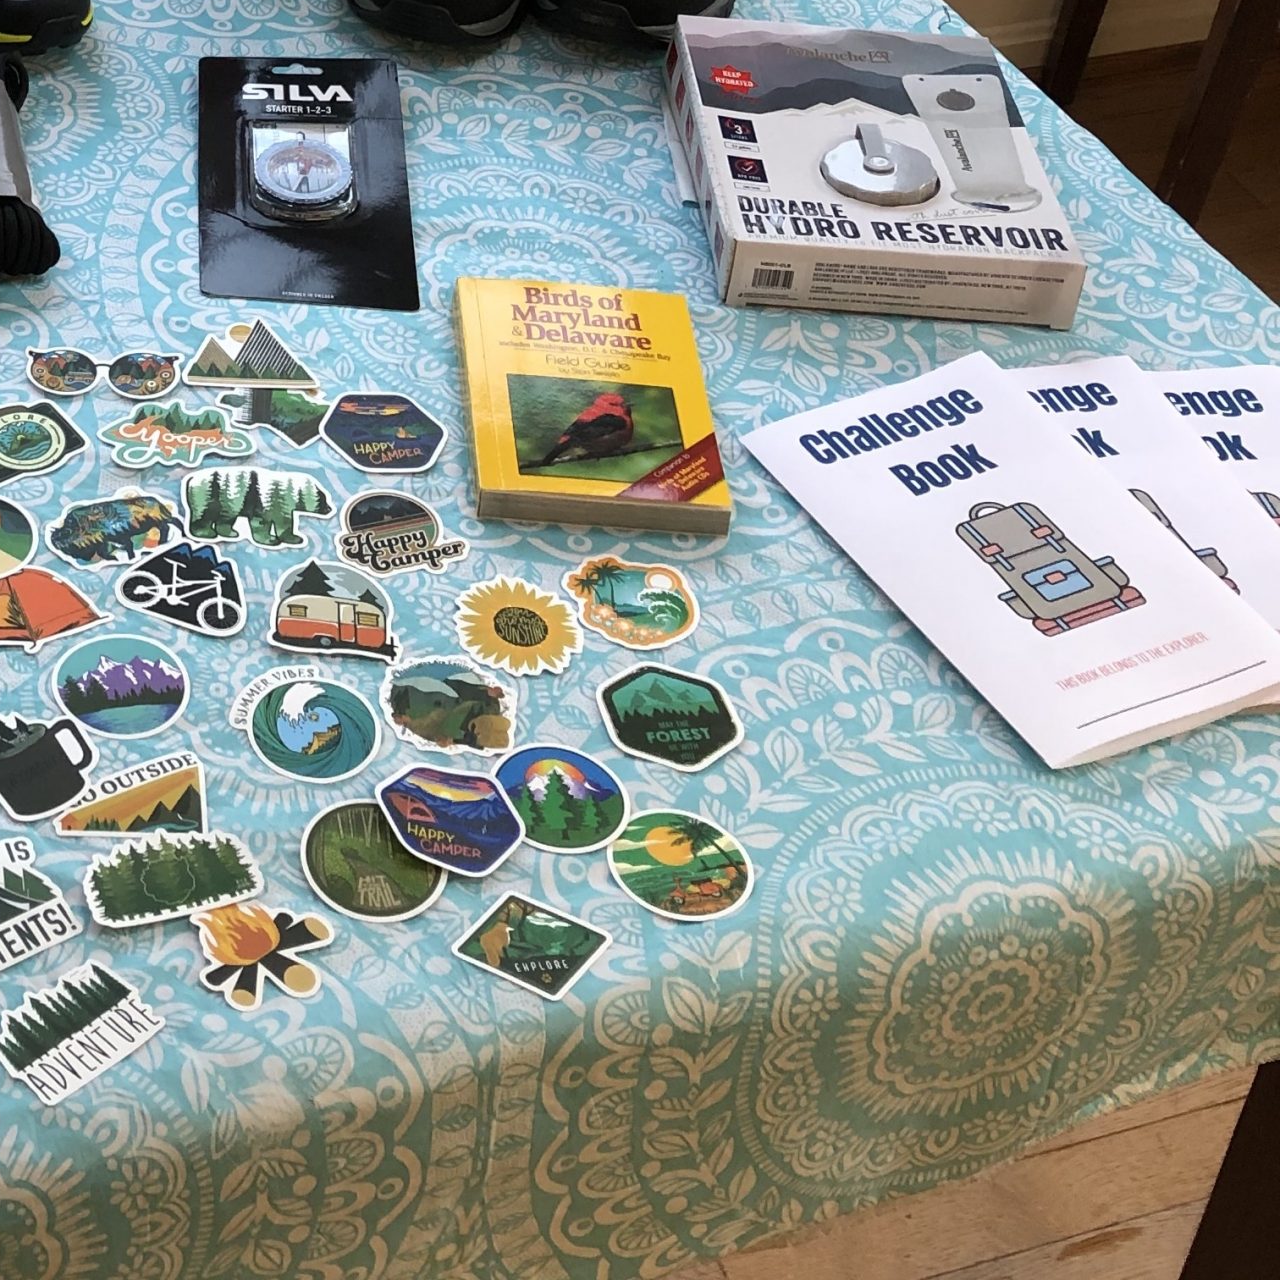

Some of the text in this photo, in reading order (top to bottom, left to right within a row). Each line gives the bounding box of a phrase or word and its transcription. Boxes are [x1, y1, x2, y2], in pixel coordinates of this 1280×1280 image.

[242, 83, 353, 101] SILVA
[266, 104, 332, 114] STARTER 1-2-3
[734, 125, 742, 135] 3
[737, 195, 848, 219] DURABLE
[743, 214, 861, 239] HYDRO
[871, 221, 1069, 251] RESERVOIR
[524, 286, 625, 312] Birds of
[511, 304, 642, 332] Maryland
[511, 325, 523, 336] &
[525, 322, 652, 350] Delaware
[545, 354, 580, 366] Field
[798, 387, 985, 465] Challenge
[354, 441, 395, 454] HAPPY
[369, 448, 424, 464] CAMPER
[888, 440, 999, 497] Book
[342, 531, 428, 564] Happy
[370, 542, 462, 570] Camper
[1055, 631, 1209, 692] THIS BOOK BELONGS TO THE EXPLORER
[234, 669, 314, 725] SUMMER VIBES
[645, 728, 711, 744] FOREST
[100, 753, 197, 795] OUTSIDE
[407, 822, 455, 843] HAPPY
[8, 839, 30, 863] IS
[420, 839, 482, 858] CAMPER
[26, 997, 160, 1101] ADVENTURE
